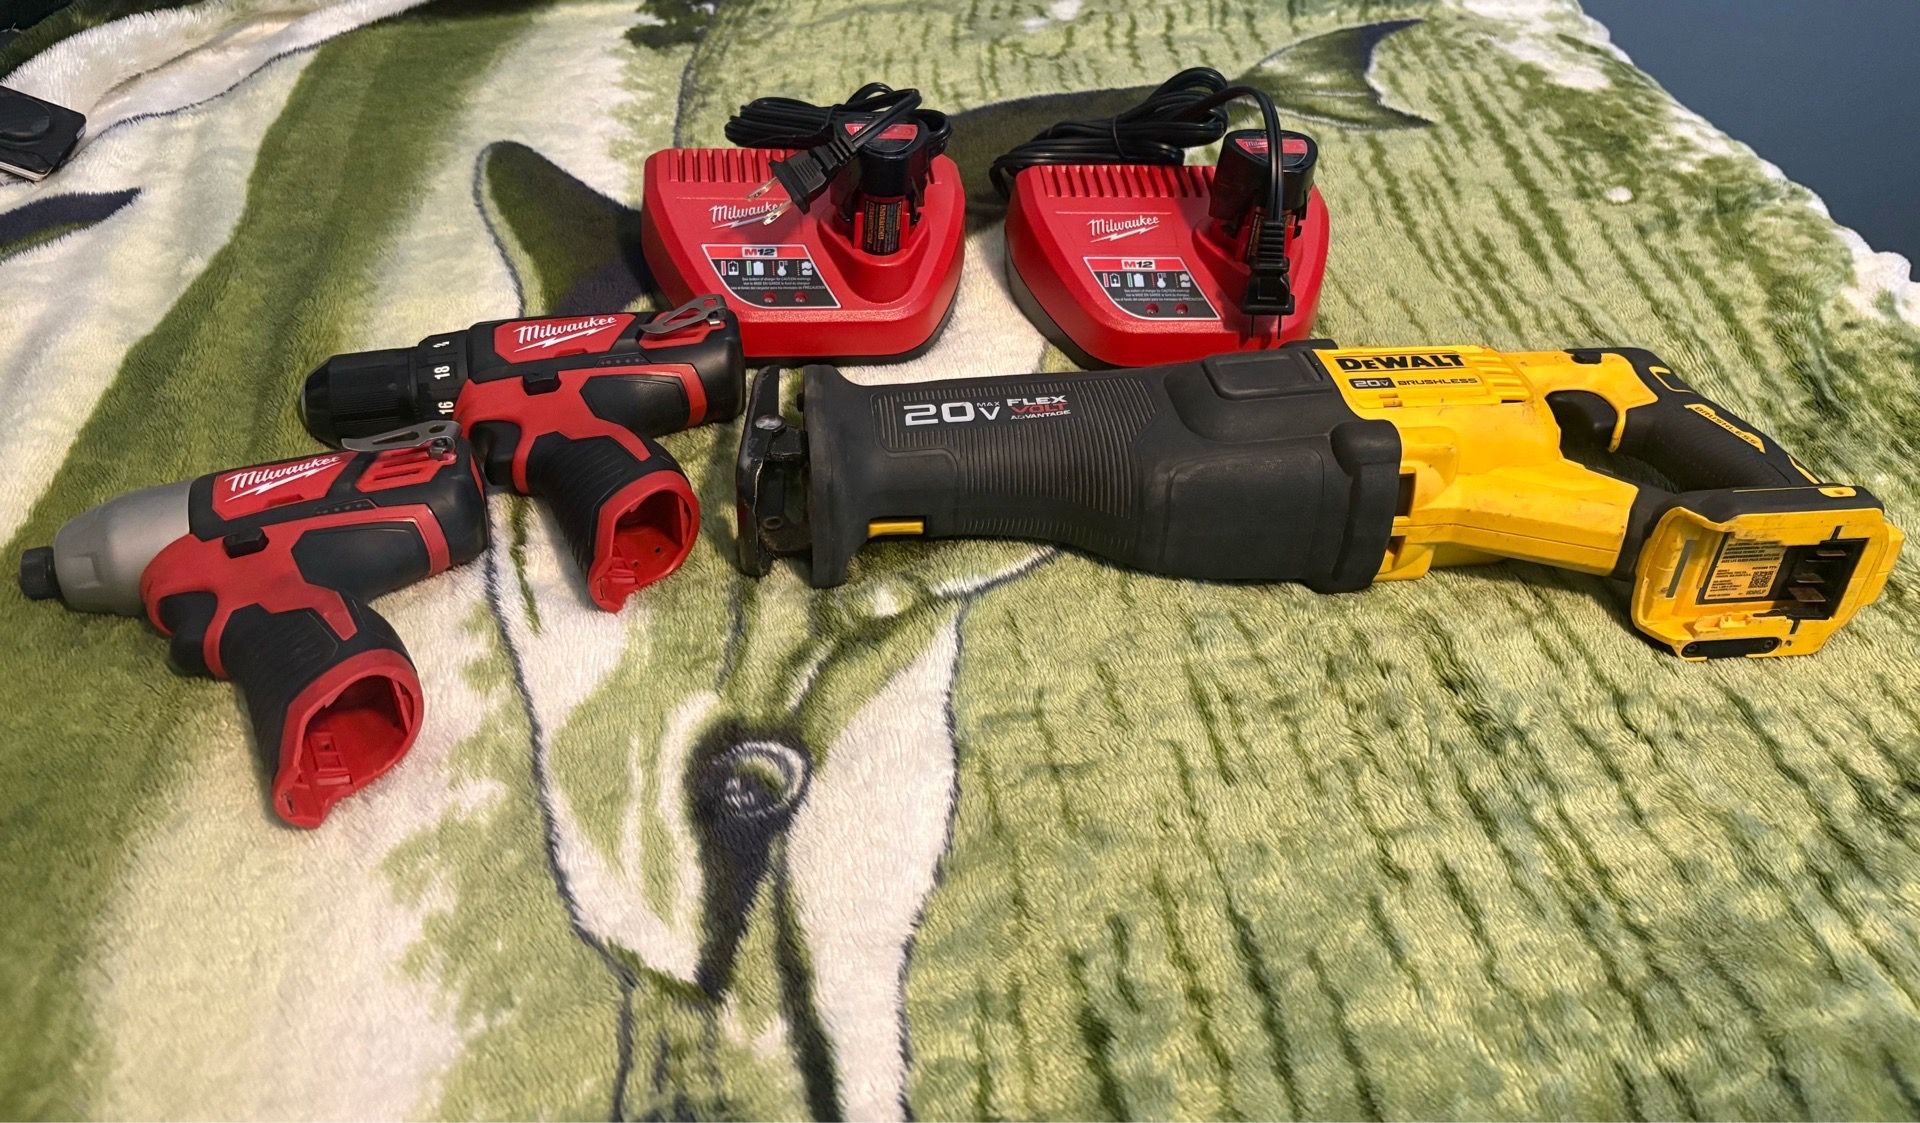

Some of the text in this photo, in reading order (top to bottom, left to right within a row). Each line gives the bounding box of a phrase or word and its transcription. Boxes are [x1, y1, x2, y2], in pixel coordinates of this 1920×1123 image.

[709, 201, 783, 223] Milwauke
[1087, 215, 1160, 236] Milwaukee
[744, 248, 776, 256] M12
[513, 316, 617, 344] Milwaukee
[434, 365, 450, 380] 18
[1397, 378, 1478, 386] BRUSHLESS
[1007, 394, 1068, 407] FLEX
[438, 401, 454, 415] 16
[1010, 403, 1070, 415] VOLT
[1010, 409, 1072, 420] ADVANTAGE
[224, 456, 341, 492] Milwaukee
